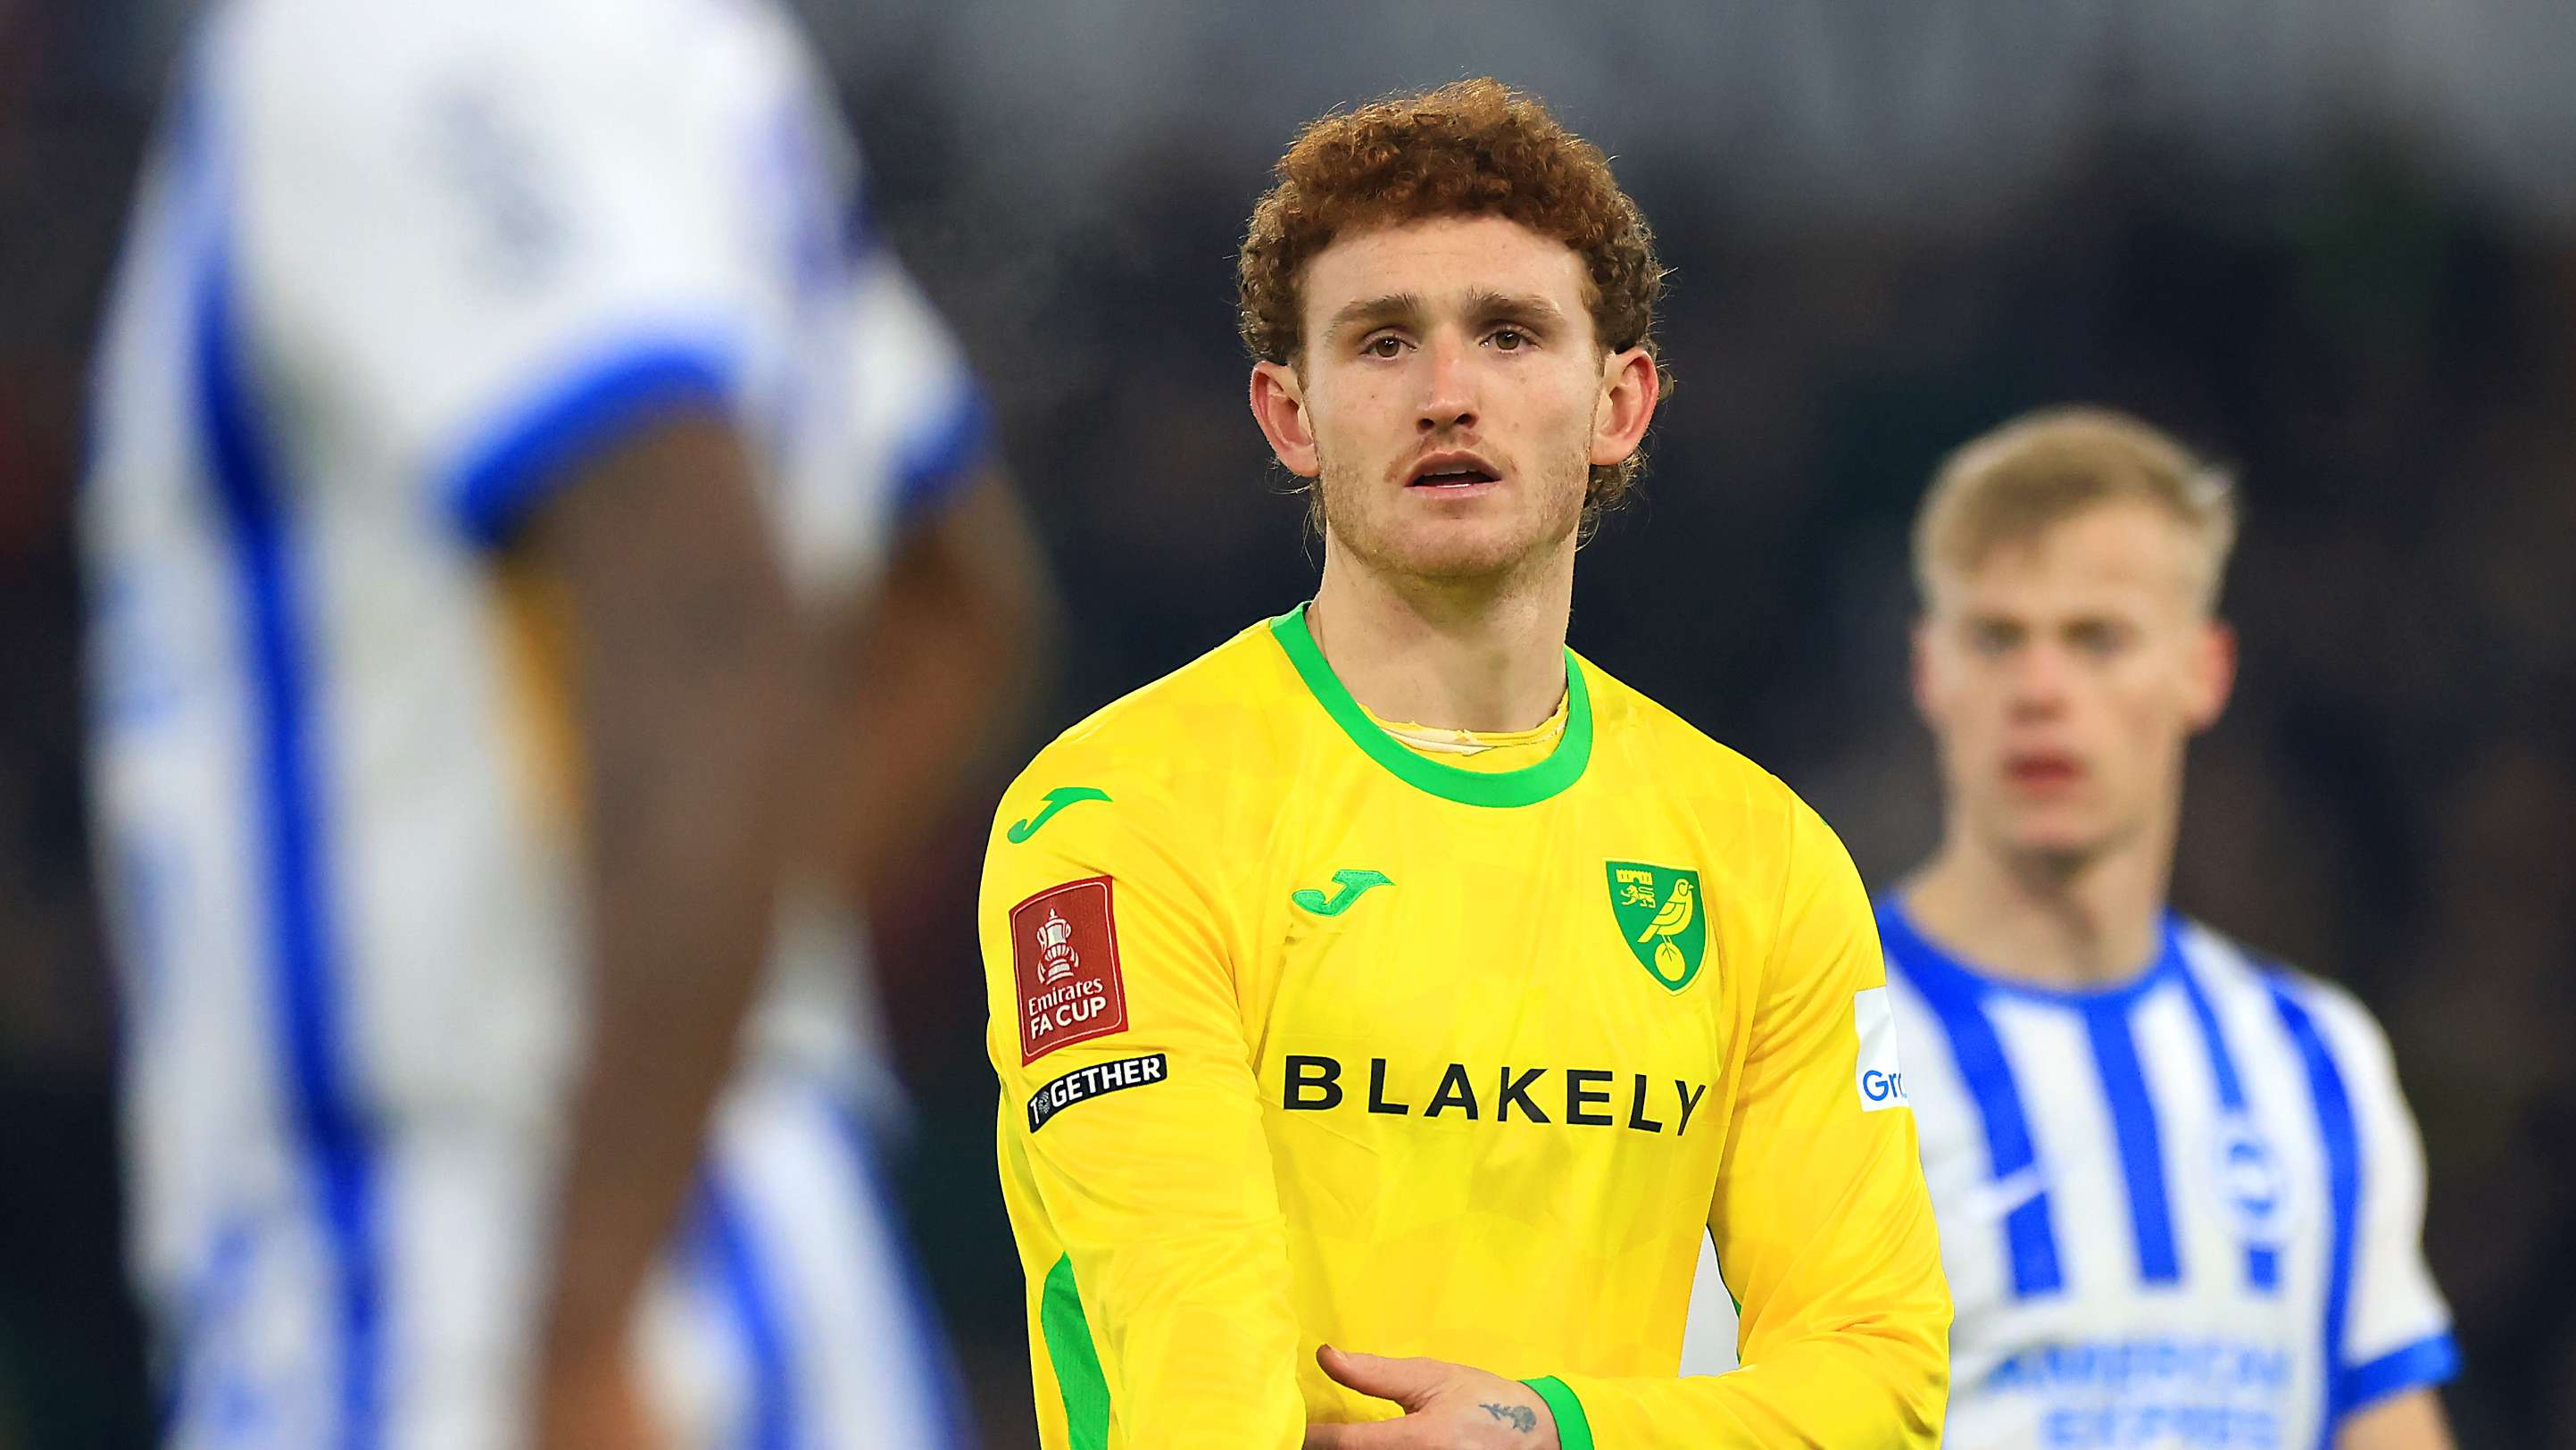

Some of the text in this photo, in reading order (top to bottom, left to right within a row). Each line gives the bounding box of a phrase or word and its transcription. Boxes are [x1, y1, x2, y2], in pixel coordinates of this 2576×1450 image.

[1028, 978, 1103, 1016] Emirates
[1030, 996, 1107, 1040] FA CUP
[1284, 1054, 1706, 1136] BLAKELY
